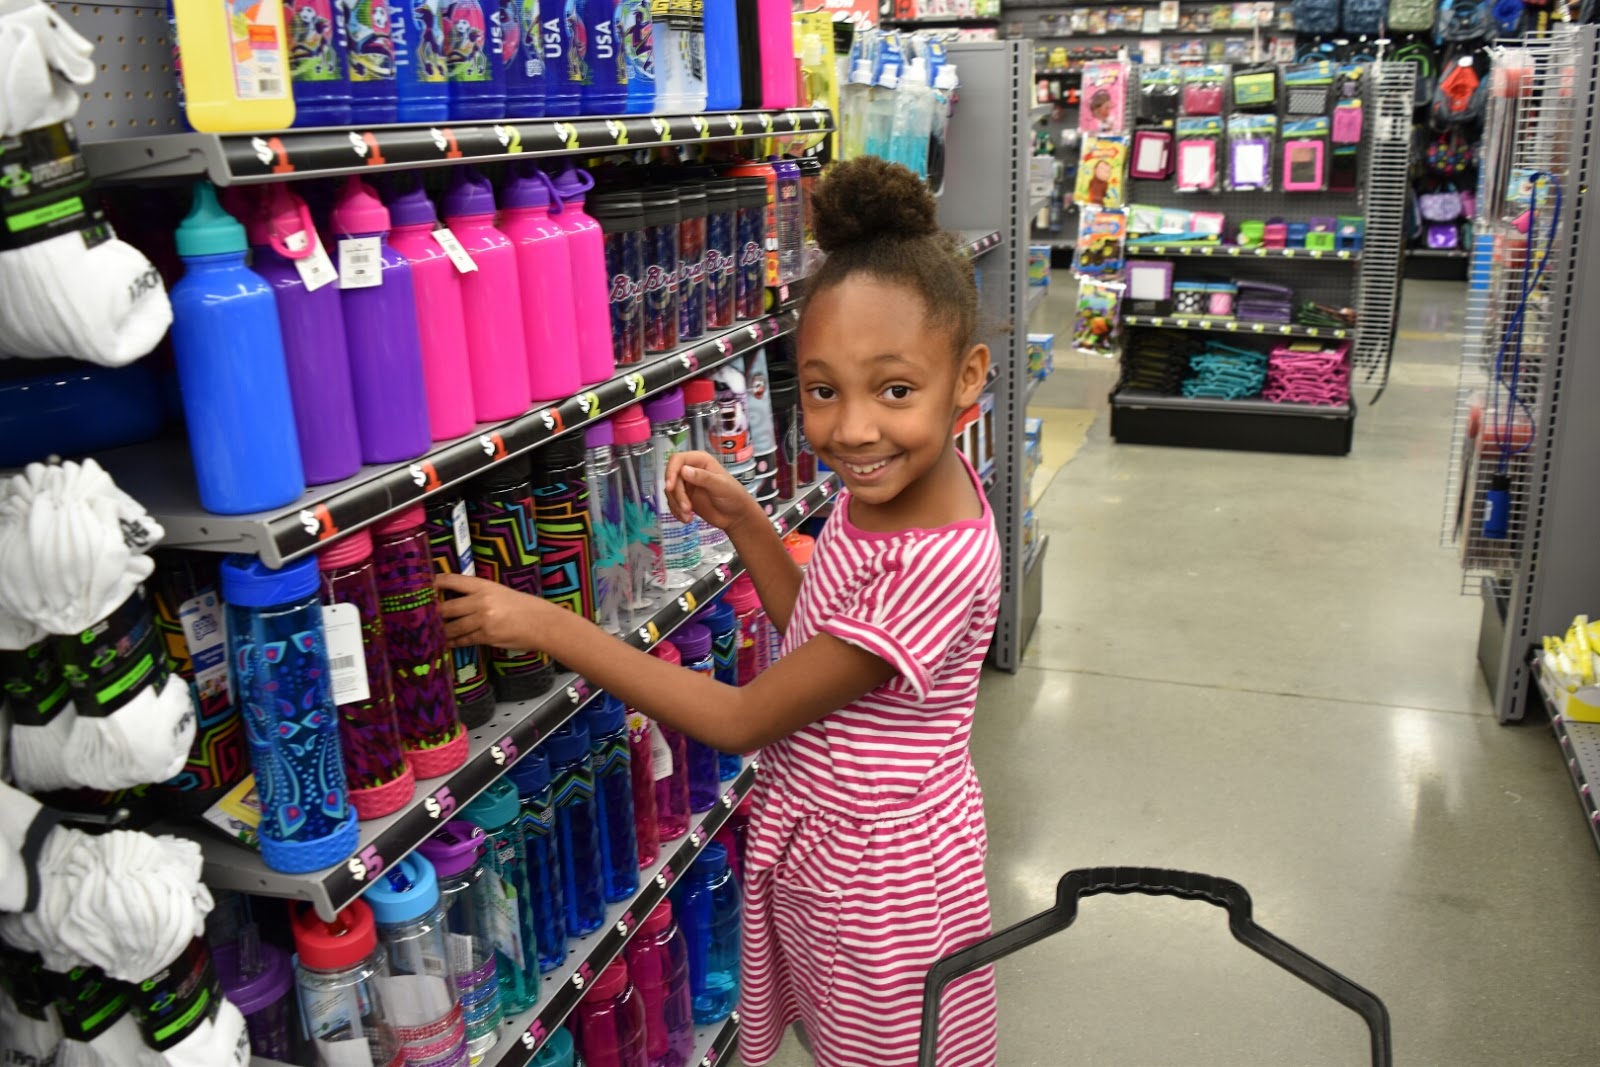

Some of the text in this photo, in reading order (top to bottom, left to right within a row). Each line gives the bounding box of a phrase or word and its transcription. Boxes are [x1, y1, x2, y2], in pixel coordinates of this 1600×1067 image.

[490, 12, 503, 54] USA
[543, 18, 562, 58] USA
[595, 20, 613, 59] USA
[554, 121, 580, 150] $2
[605, 119, 629, 146] $2
[650, 117, 672, 143] $2
[691, 116, 710, 139] $2
[726, 113, 744, 136] $2
[758, 112, 774, 134] $2
[349, 131, 386, 166] $1
[430, 127, 463, 159] $1
[494, 124, 523, 154] $2
[252, 136, 295, 174] $1
[748, 322, 764, 343] $5
[715, 336, 733, 358] $5
[679, 350, 699, 373] $5
[624, 372, 646, 398] $2
[577, 392, 601, 419] $2
[540, 406, 566, 435] $1
[480, 432, 509, 462] $1
[409, 460, 442, 493] $1
[818, 481, 833, 497] $5
[795, 499, 810, 516] $5
[300, 504, 338, 542] $1
[773, 517, 788, 535] $5
[714, 563, 732, 583] $5
[566, 677, 591, 705] $5
[490, 735, 519, 766] $5
[424, 785, 457, 819] $5
[721, 787, 738, 809] $5
[690, 825, 707, 848] $5
[348, 844, 384, 881] $5
[656, 864, 676, 889] $5
[616, 911, 637, 937] $5
[571, 961, 595, 990] $5
[521, 1018, 548, 1050] $5
